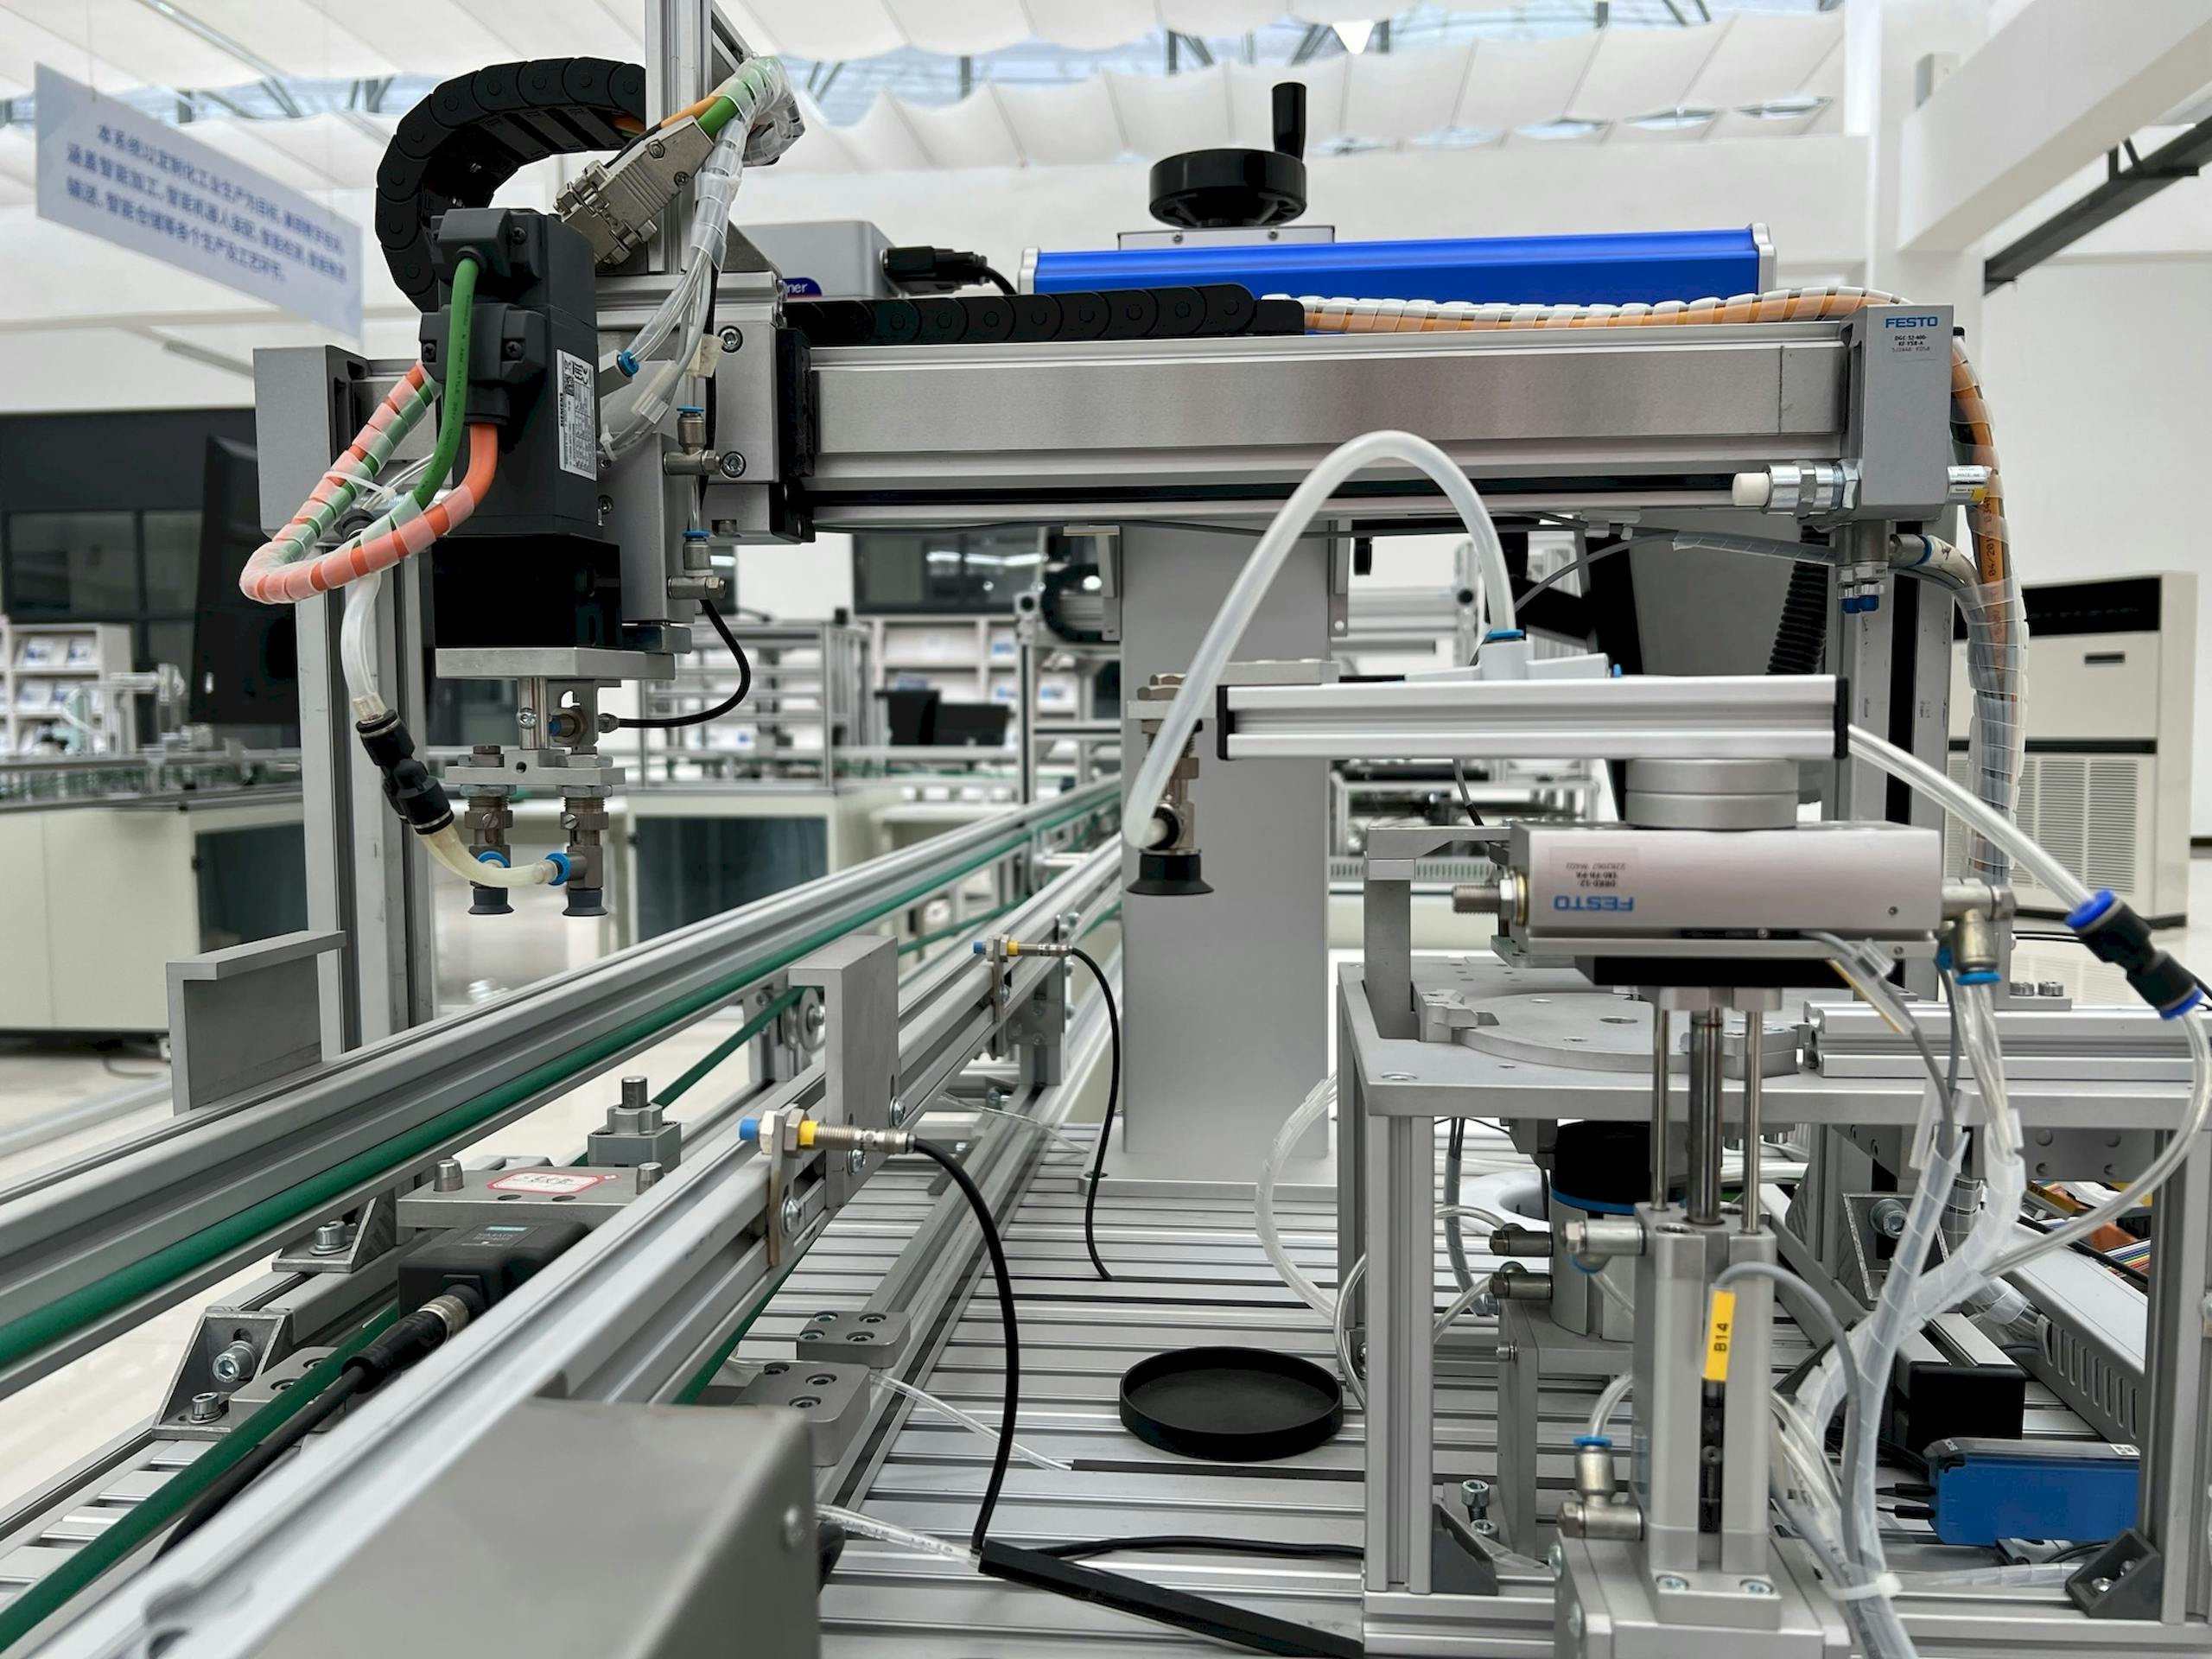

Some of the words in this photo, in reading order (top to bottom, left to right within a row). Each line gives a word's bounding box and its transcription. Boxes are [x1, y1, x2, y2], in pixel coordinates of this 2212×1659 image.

[1885, 316, 1938, 328] FESTO
[1554, 895, 1634, 912] FESTO
[1713, 1322, 1728, 1352] B14
